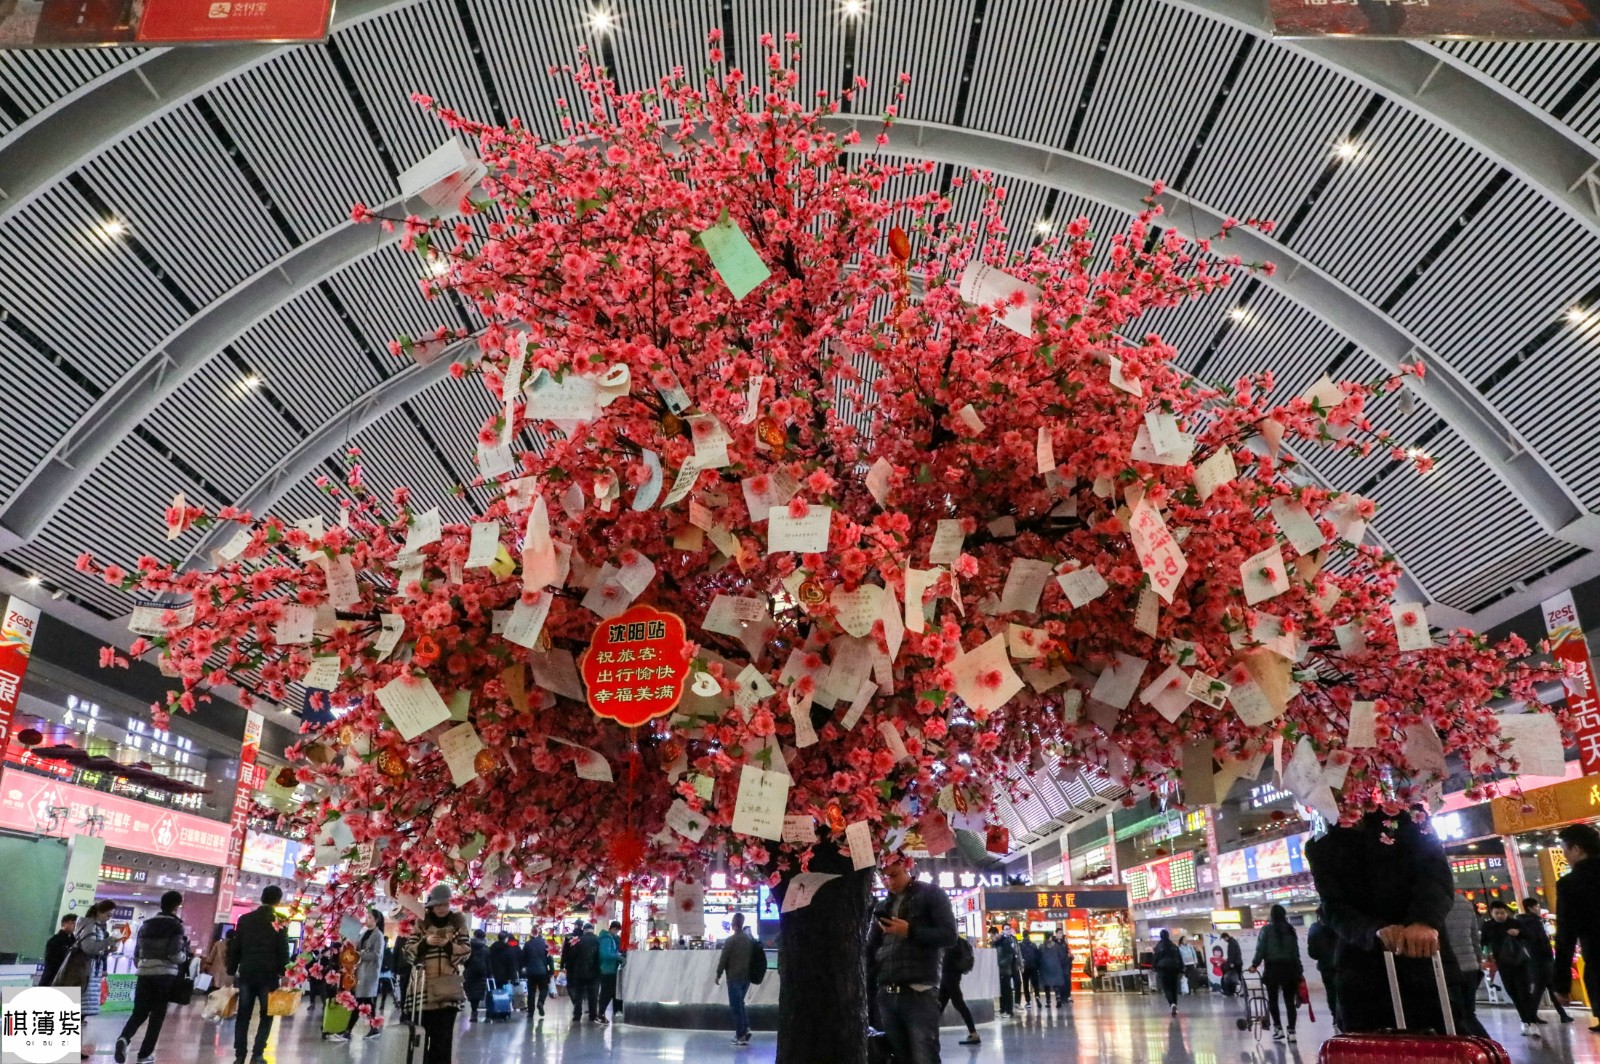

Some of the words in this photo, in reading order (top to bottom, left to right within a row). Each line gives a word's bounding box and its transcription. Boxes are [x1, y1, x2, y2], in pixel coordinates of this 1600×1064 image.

[233, 2, 267, 12] 支付宝
[608, 620, 665, 643] 沈阳站
[596, 665, 676, 683] 出行愉快
[594, 685, 675, 704] 幸福美满
[1488, 858, 1502, 868] B12
[134, 871, 146, 881] A13
